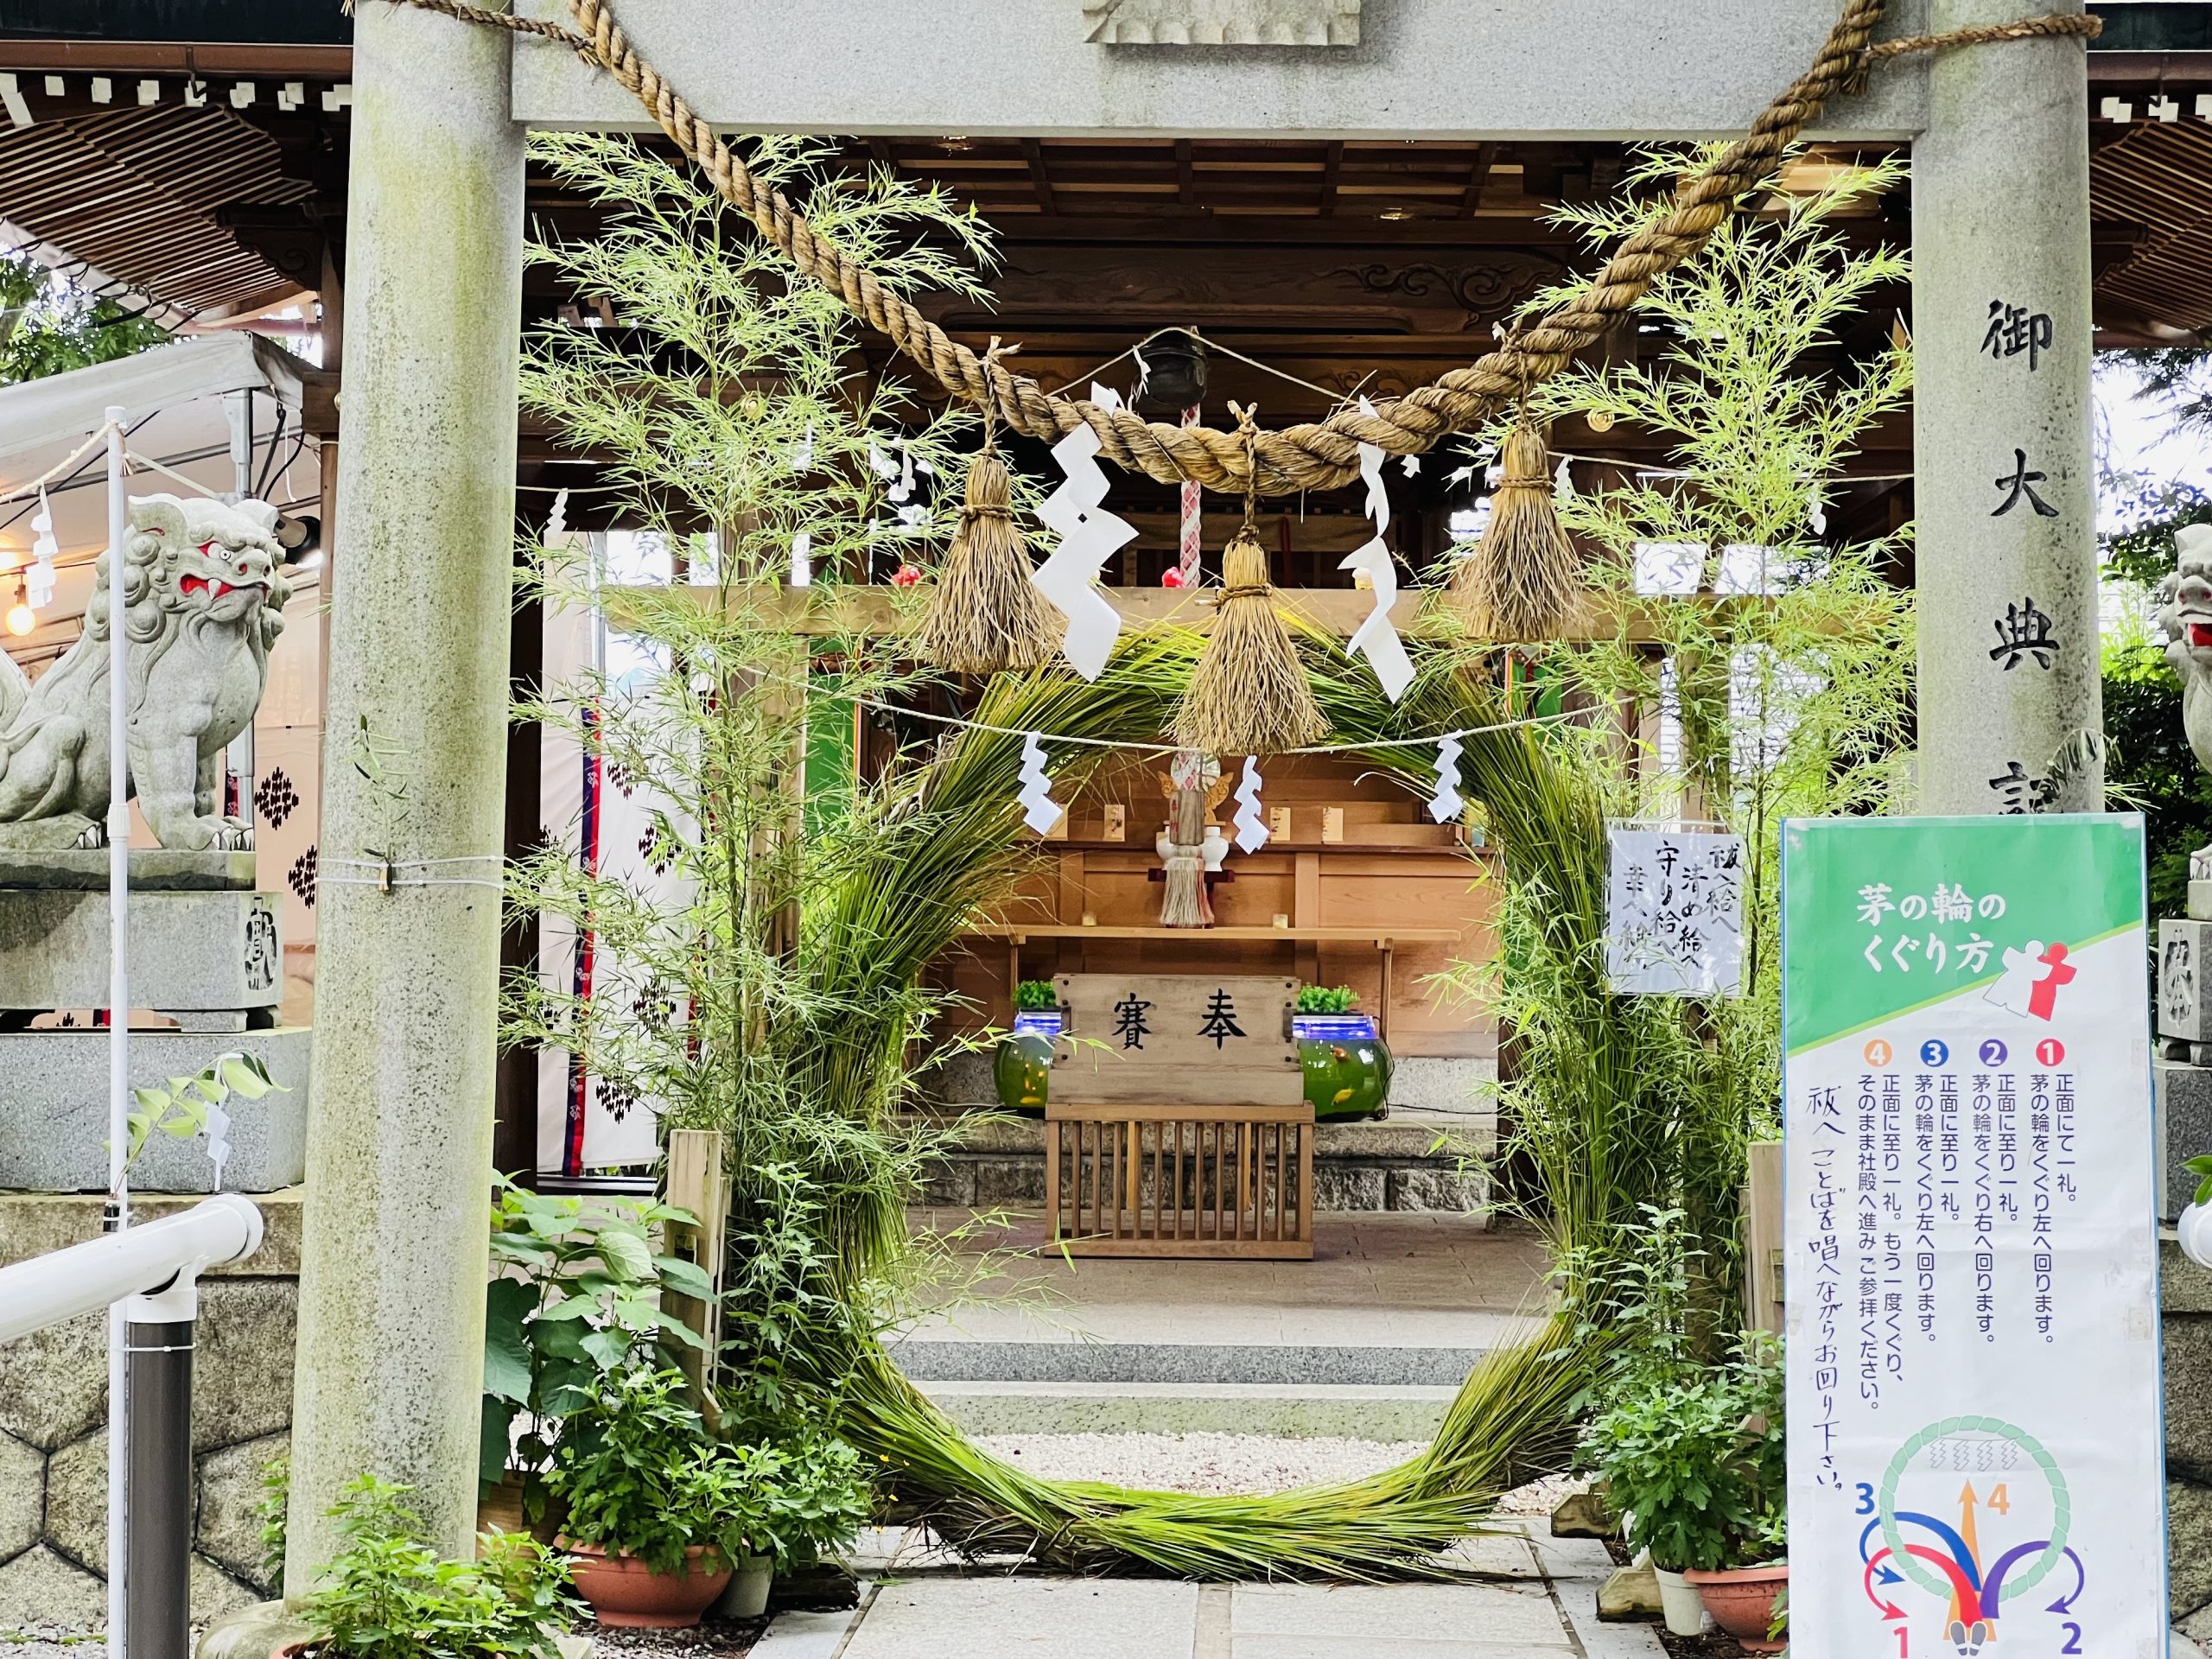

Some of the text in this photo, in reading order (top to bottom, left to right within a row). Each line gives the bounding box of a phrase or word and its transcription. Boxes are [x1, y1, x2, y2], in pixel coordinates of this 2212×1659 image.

[1619, 863, 1651, 969] 幸へ給
[1857, 883, 2006, 927] 茅の輪の
[1864, 932, 1994, 974] くぐり方
[1940, 1074, 1960, 1222] 正面に至り一礼。
[1997, 1074, 2018, 1222] 正面に至り一礼。
[2056, 1074, 2076, 1202] 正面にて一礼。
[1858, 1074, 1879, 1410] そのまま社殿へ進みご参拝ください。
[1915, 1074, 1936, 1342] 茅の輪をくぐり左へ回ります。
[1972, 1074, 1994, 1343] 茅の輪をくぐり右へ回ります。
[2030, 1074, 2054, 1343] 茅の輪をくぐり左へ回ります。
[1855, 1483, 1875, 1515] 3
[1987, 1484, 2010, 1516] 4
[1893, 1626, 1909, 1658] 1
[2061, 1622, 2082, 1655] 2
